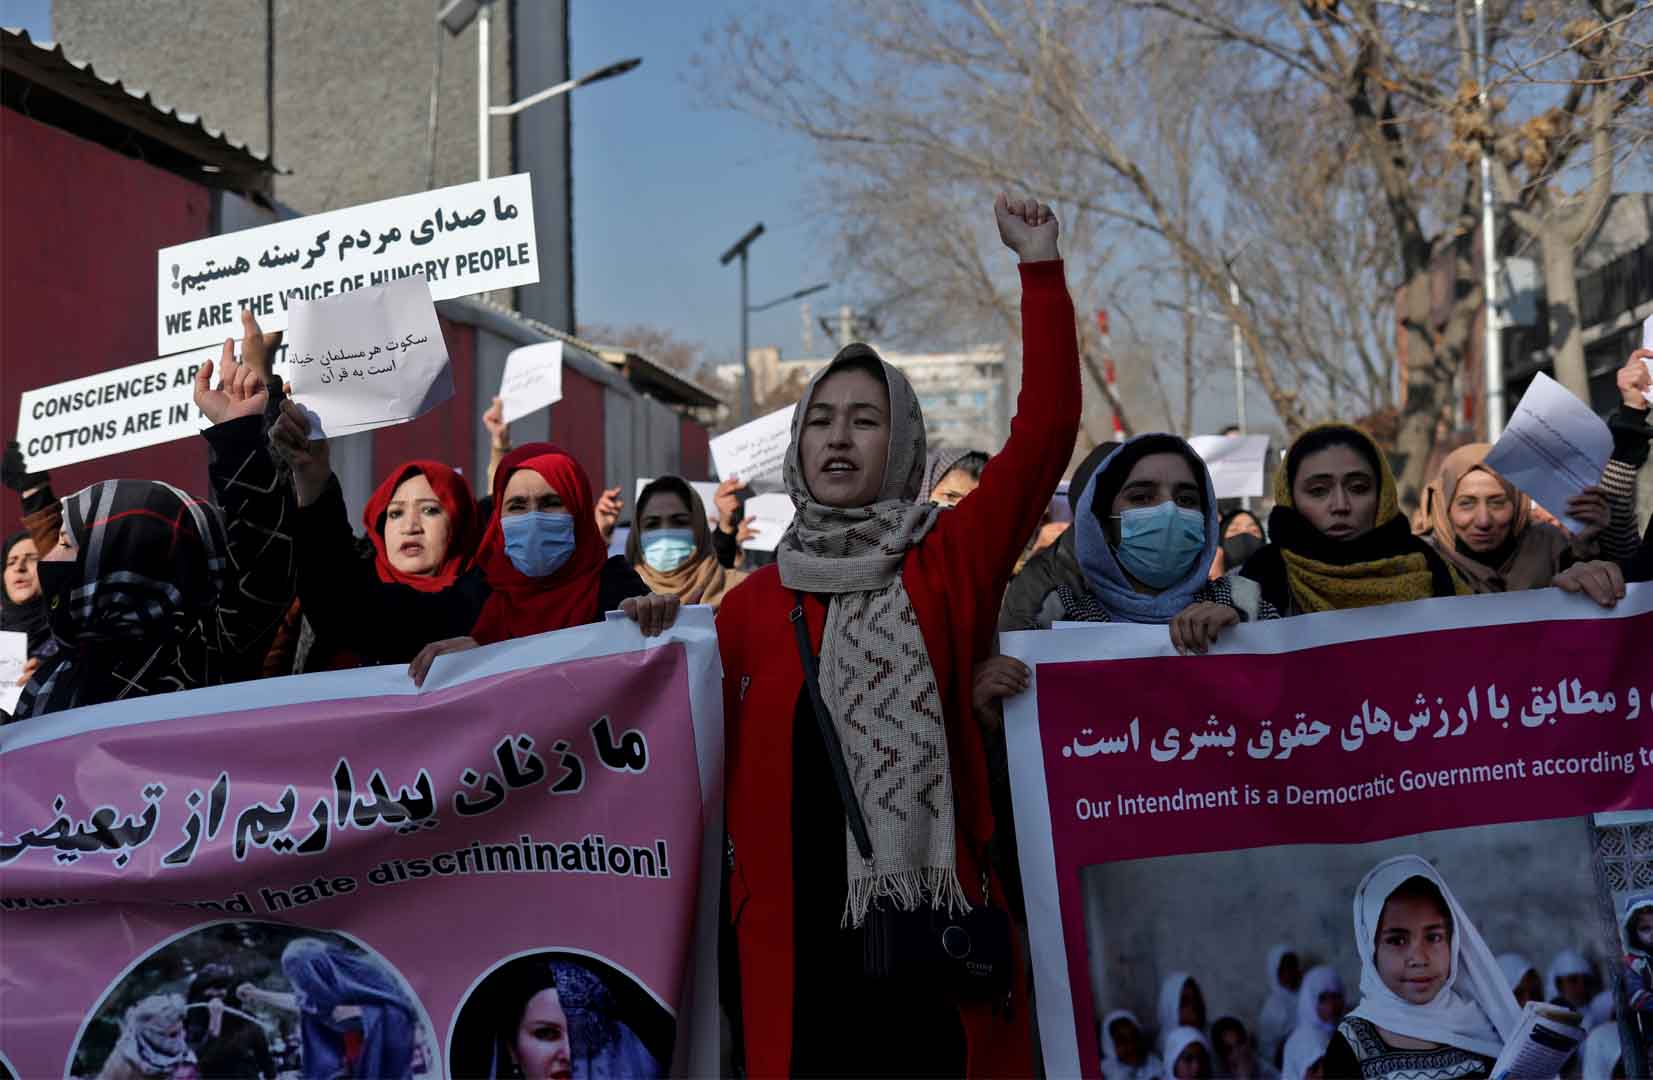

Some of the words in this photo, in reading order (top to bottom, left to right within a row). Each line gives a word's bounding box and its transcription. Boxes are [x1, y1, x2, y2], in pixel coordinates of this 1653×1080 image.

[410, 207, 486, 246] صدای
[493, 195, 519, 221] ما
[258, 230, 330, 270] گرسنه
[338, 226, 402, 261] مردم
[165, 310, 192, 336] WE
[197, 302, 233, 329] ARE
[455, 242, 530, 277] PEOPLE
[386, 334, 428, 353] سکوت
[320, 366, 349, 384] قرآن
[352, 368, 364, 380] به
[367, 359, 397, 376] است
[32, 372, 168, 421] CONSCIENCES
[173, 363, 205, 388] AR
[27, 420, 117, 458] COTTONS
[123, 409, 162, 437] ARE
[168, 403, 190, 425] IN
[1487, 683, 1510, 729] با
[1520, 677, 1617, 728] مطابق
[1625, 687, 1641, 720] و
[591, 716, 648, 773] ما
[1151, 714, 1237, 762] بشری
[1247, 713, 1331, 760] حقوق
[455, 735, 585, 817] زنان
[1075, 798, 1112, 821] Our
[1118, 786, 1239, 816] Intendment
[1245, 784, 1260, 805] is
[1266, 789, 1279, 805] a
[1286, 774, 1395, 806] Democratic
[1400, 759, 1526, 791] Government
[1532, 751, 1635, 774] according
[161, 771, 229, 868] از
[234, 757, 439, 861] بیداریم
[259, 875, 358, 914] hate
[367, 834, 671, 885] discrimination!
